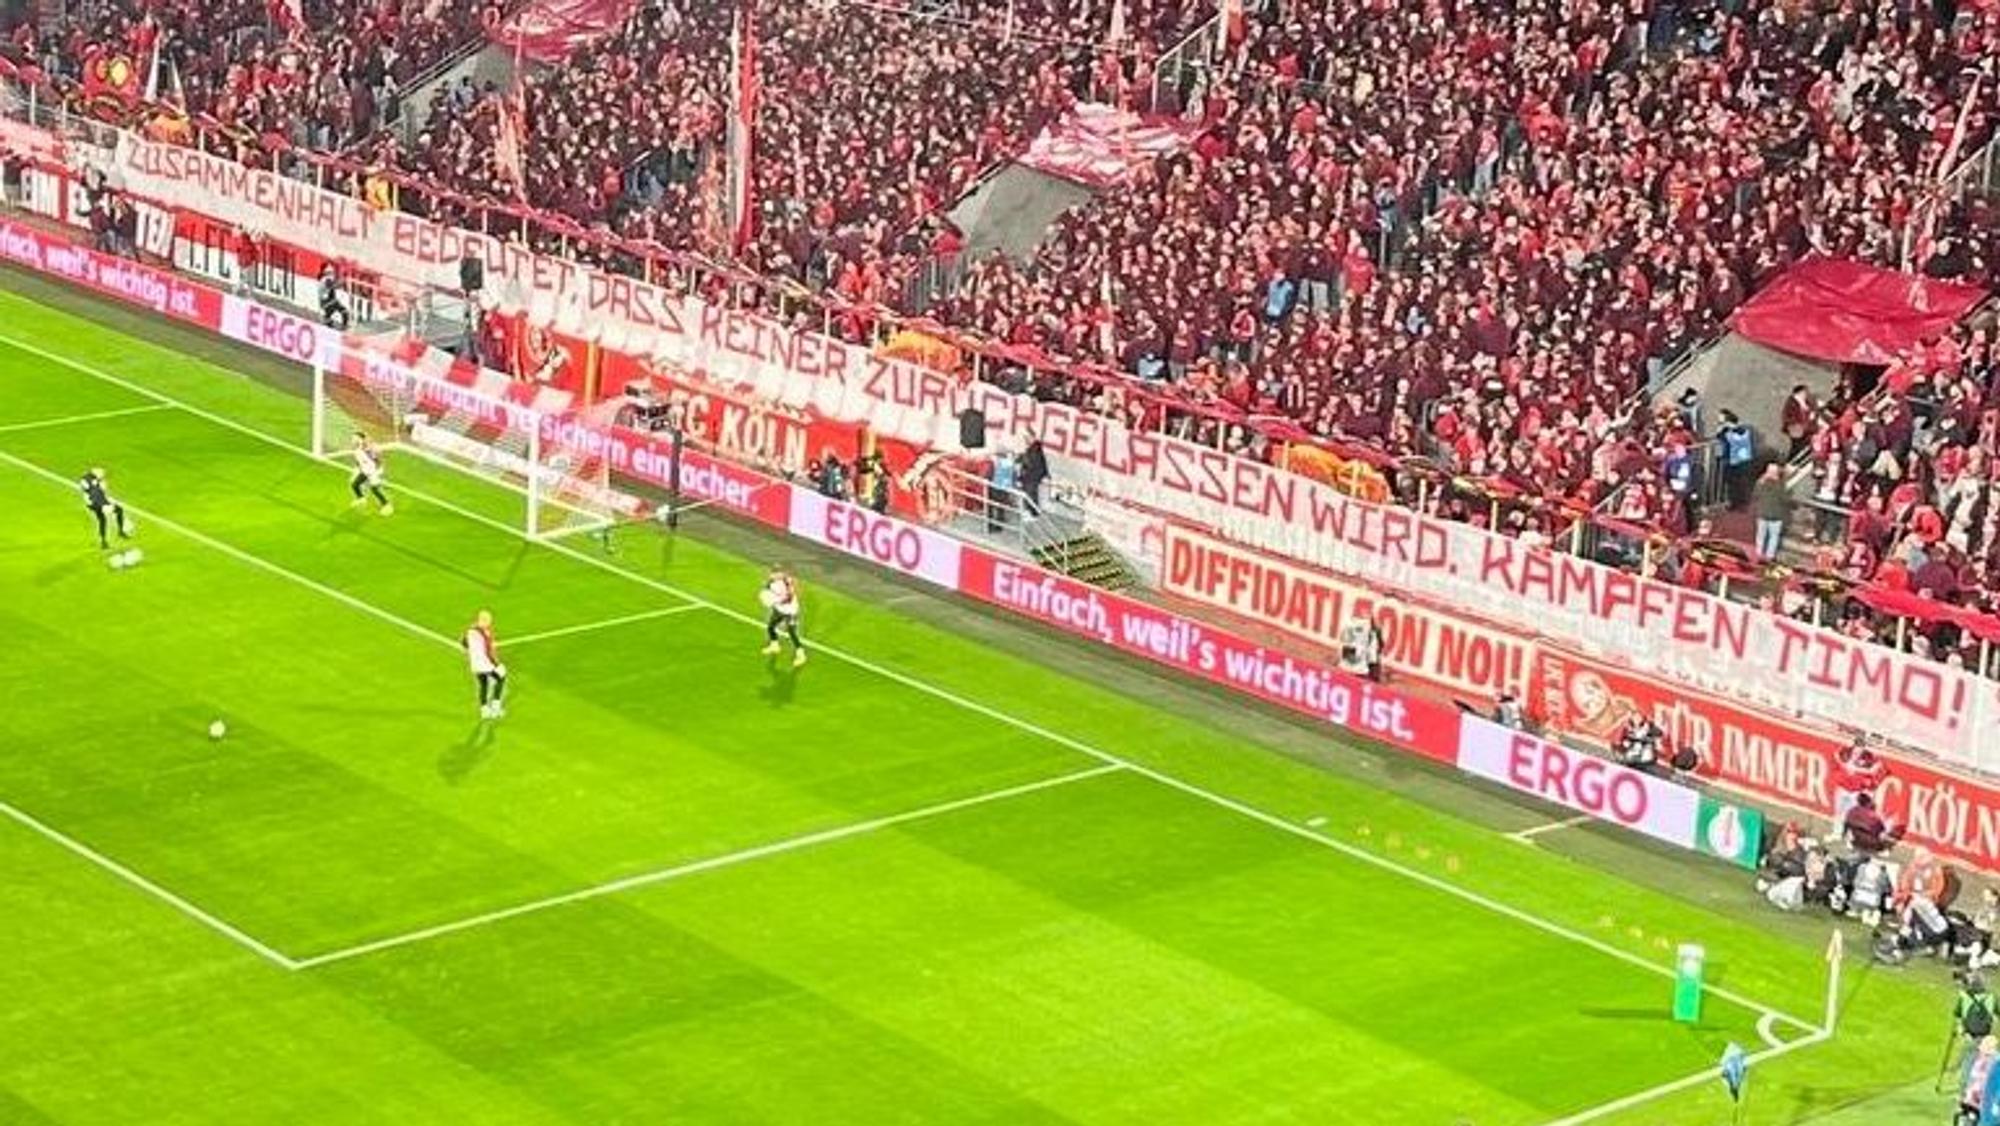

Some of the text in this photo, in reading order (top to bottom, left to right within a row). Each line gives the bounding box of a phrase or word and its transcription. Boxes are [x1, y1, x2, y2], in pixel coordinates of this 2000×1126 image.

[247, 306, 316, 360] ERGO
[127, 137, 375, 239] ZUSAMMENHALT
[588, 270, 684, 333] DASS
[701, 302, 846, 384] KEINER
[1311, 485, 1458, 573] WIRD.
[1481, 533, 1751, 659] KÄMPFEN
[1773, 617, 1965, 729] TIMO!
[632, 442, 759, 512] einacher.
[825, 503, 922, 571] ERGO
[1170, 537, 1342, 639] DIFFIDATI
[993, 560, 1415, 741] Einfach, weil's wichtig ist.
[1509, 737, 1649, 825] ERGO
[1720, 722, 1833, 811] IMMER
